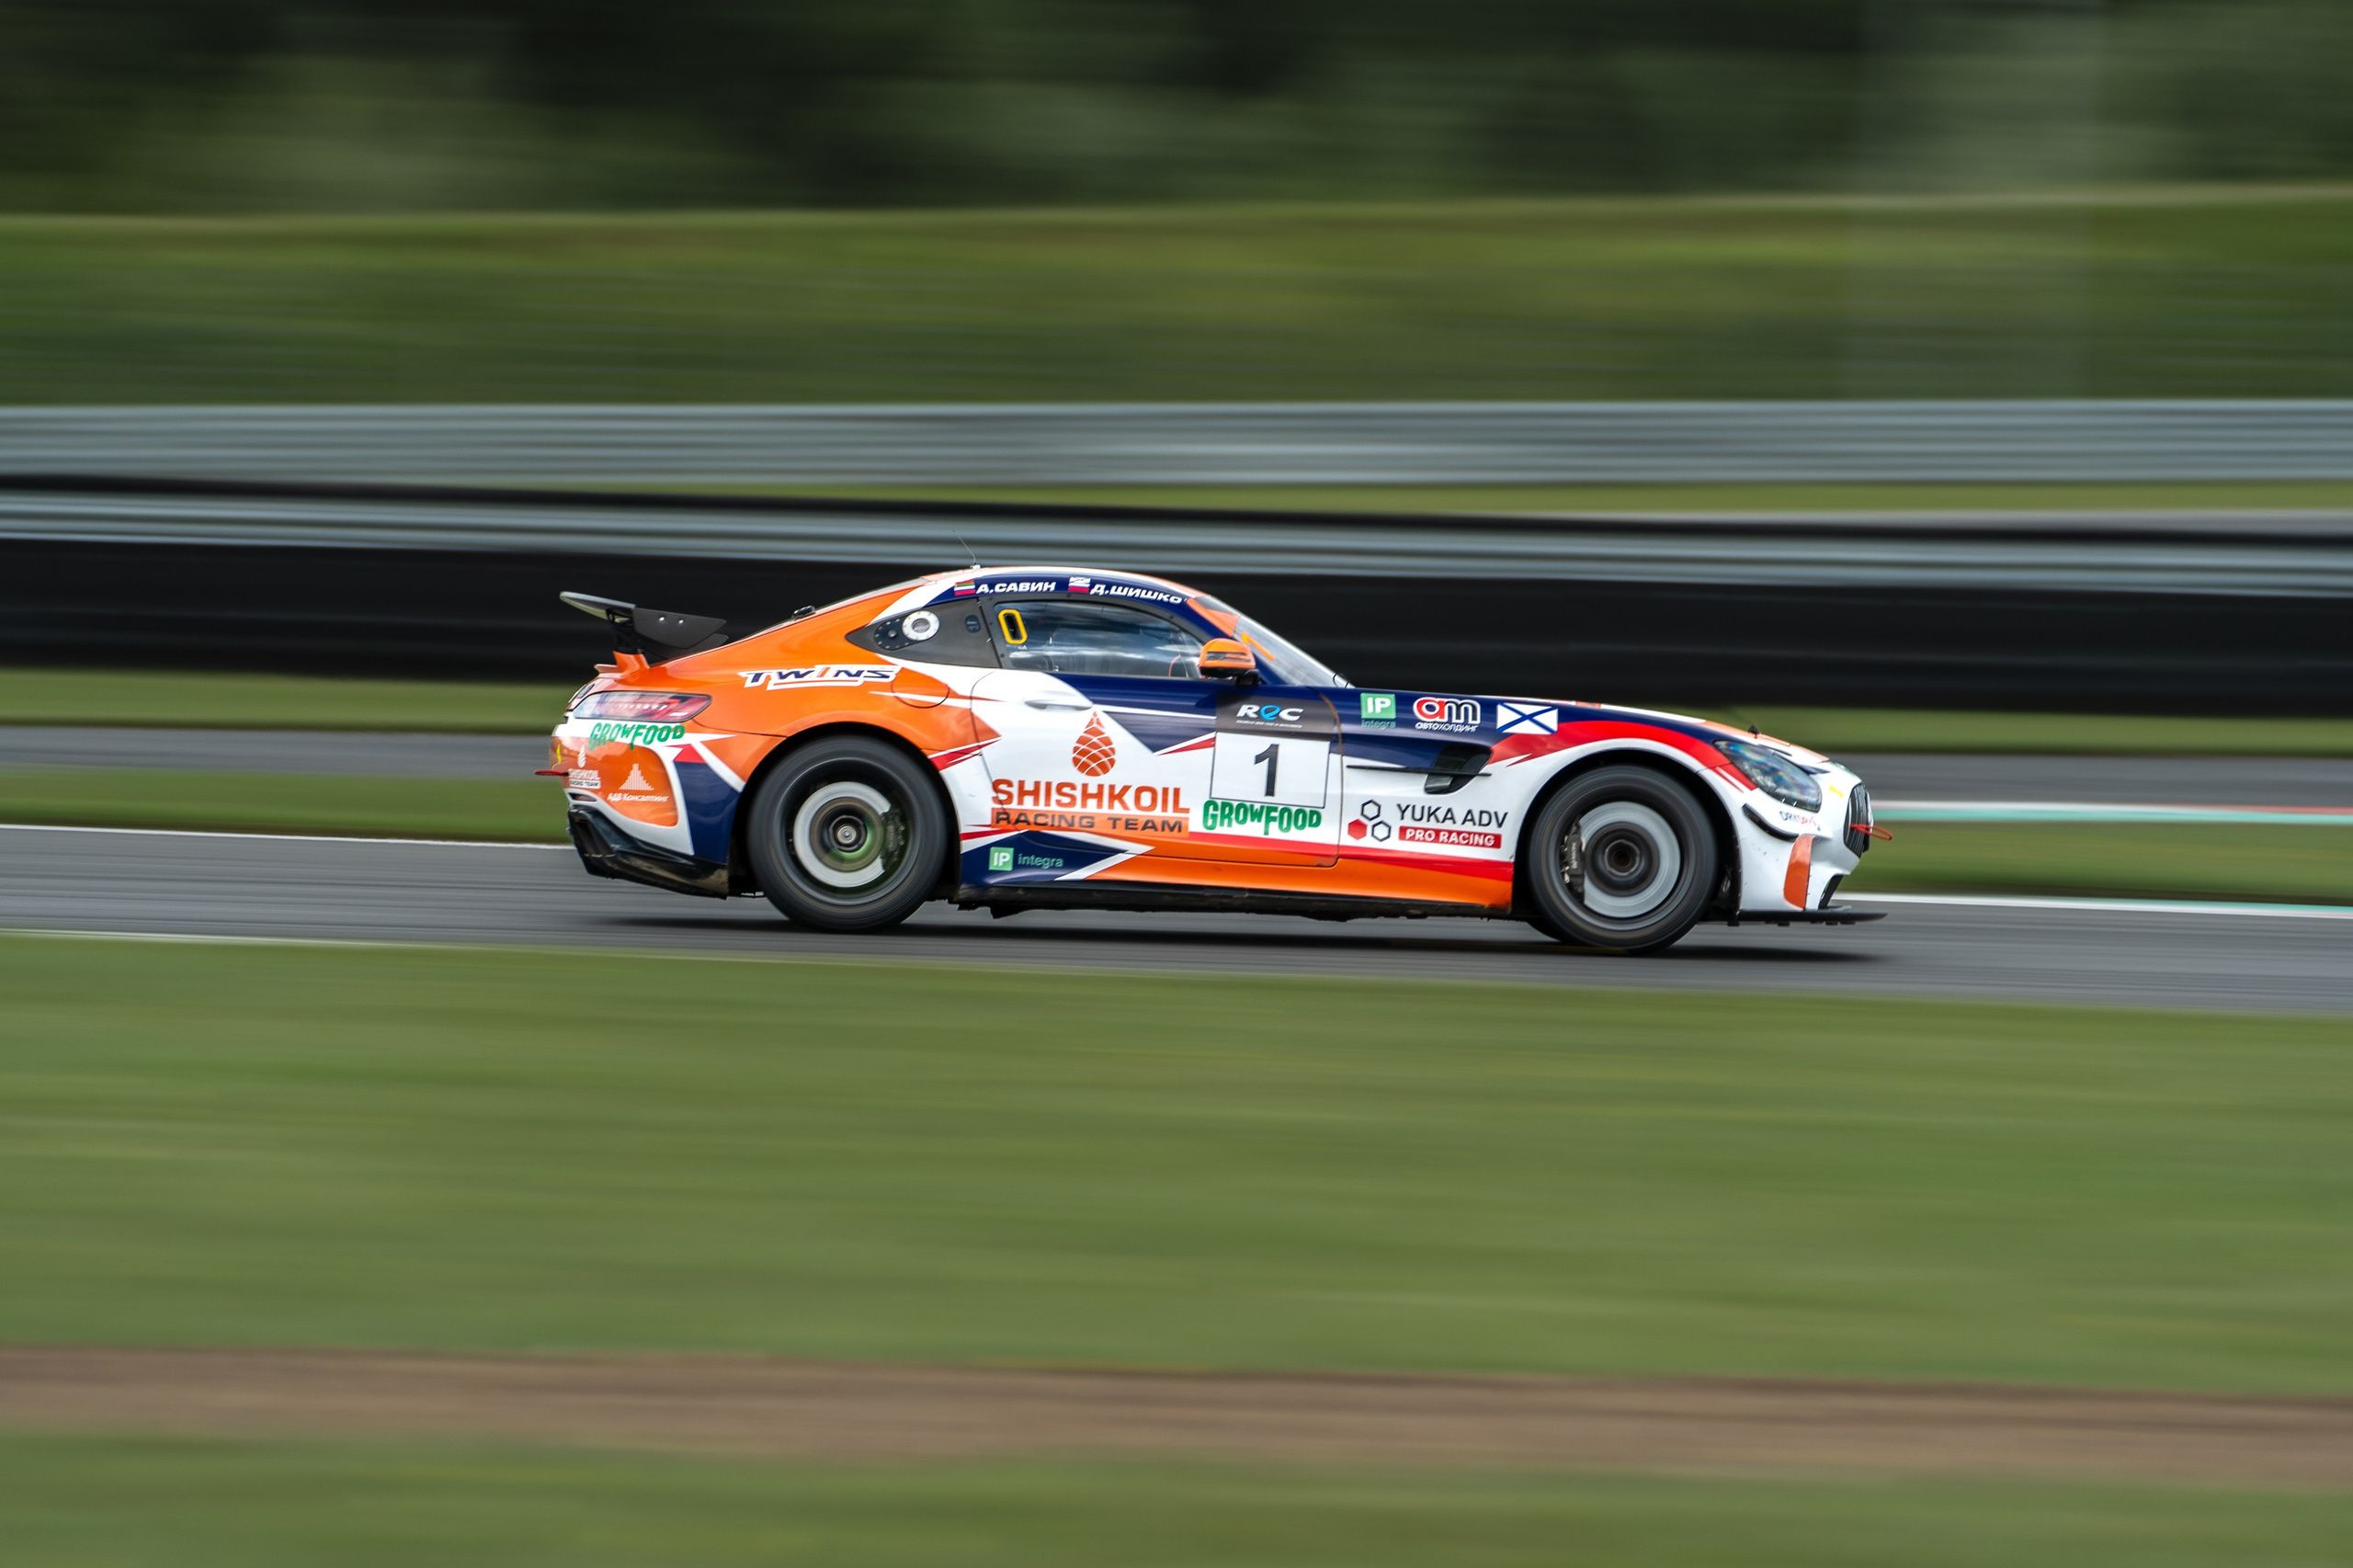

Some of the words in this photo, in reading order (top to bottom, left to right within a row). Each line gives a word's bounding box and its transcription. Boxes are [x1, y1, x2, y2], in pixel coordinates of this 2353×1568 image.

[975, 581, 1057, 595] А.САВИН
[743, 665, 897, 686] TWINS
[1367, 697, 1392, 714] IP
[588, 722, 686, 751] GROWFOOD
[1254, 744, 1280, 797] 1
[992, 778, 1190, 813] SHISHKOIL
[995, 812, 1095, 829] RACING
[1108, 817, 1184, 834] TEAM
[1202, 800, 1323, 835] GROWFOOD
[1396, 803, 1455, 825] YUKA
[1461, 809, 1509, 829] ADV
[1404, 829, 1436, 843] PRO
[1438, 832, 1495, 847] RACING
[992, 851, 1010, 867] IP
[1017, 854, 1063, 869] integra
